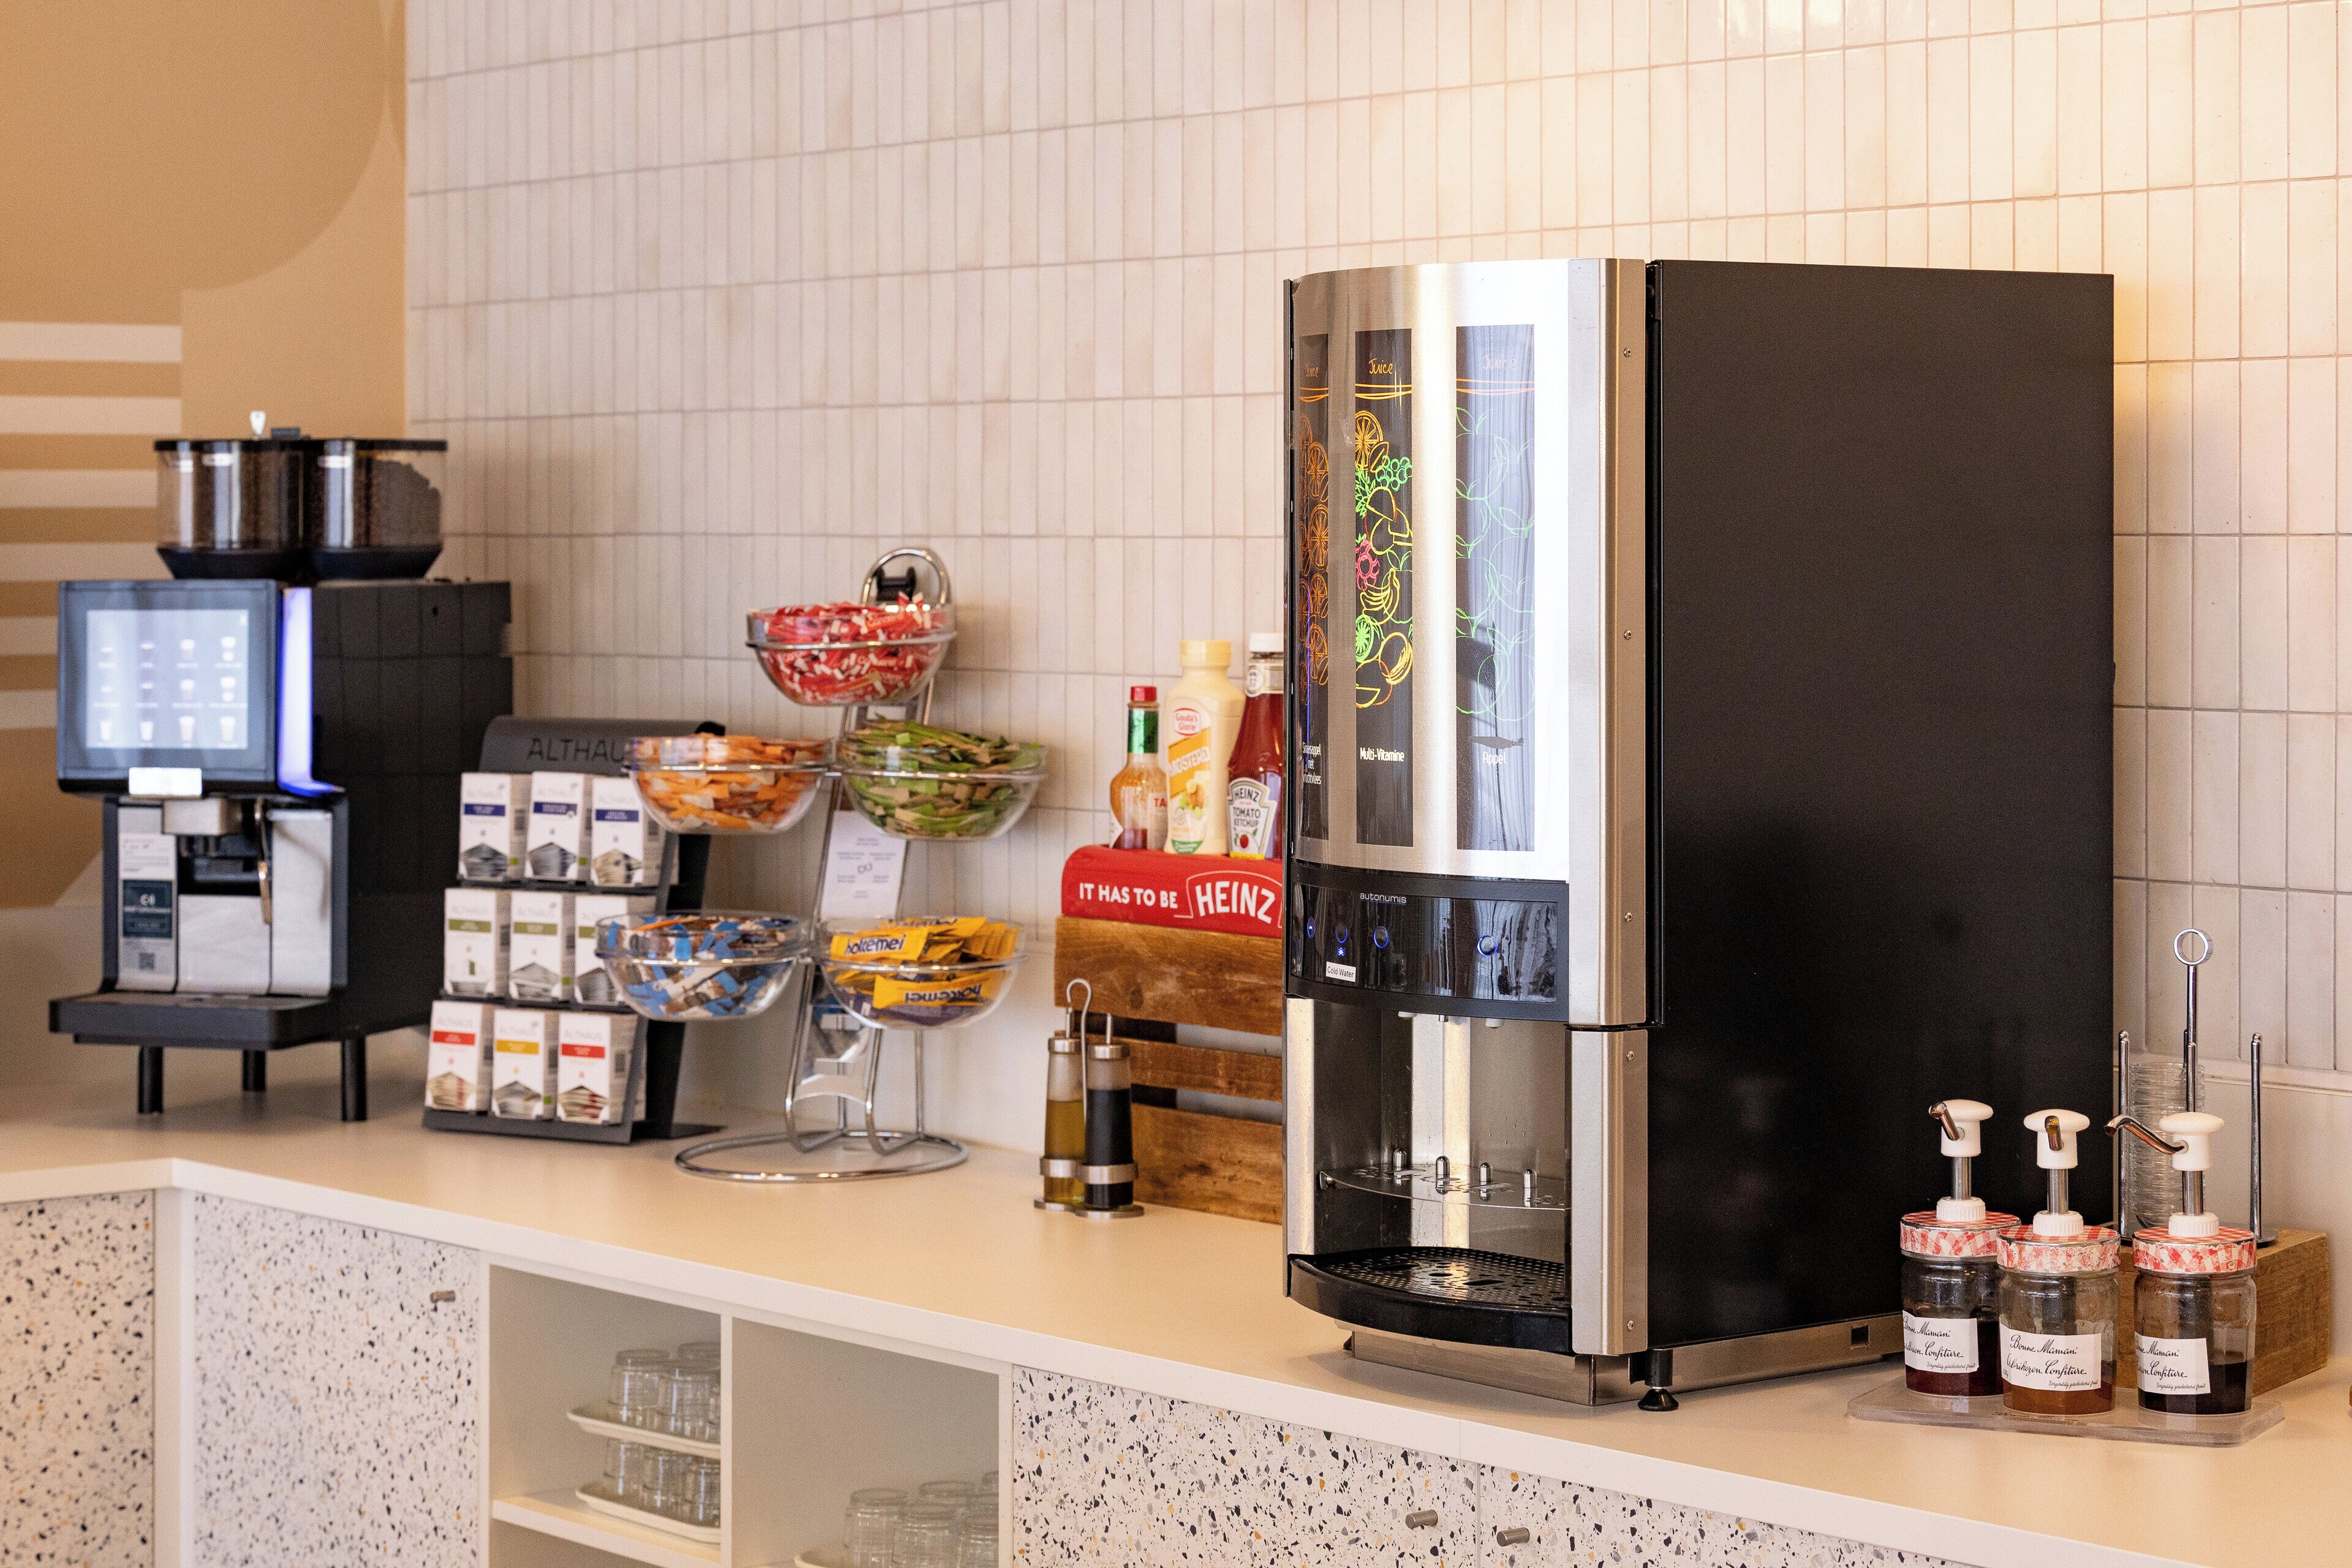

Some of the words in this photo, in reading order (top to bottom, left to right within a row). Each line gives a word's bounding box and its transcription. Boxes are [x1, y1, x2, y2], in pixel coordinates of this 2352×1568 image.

[1368, 357, 1393, 374] Juice
[1482, 355, 1516, 370] Juice
[527, 737, 625, 763] ALTHAU
[1360, 747, 1405, 762] Multi-Vitamine
[1482, 751, 1507, 766] Appel
[1234, 788, 1259, 802] HEINZ
[1233, 807, 1261, 818] TOMATO
[1234, 818, 1260, 827] KETCHUP
[1079, 882, 1095, 900] IT
[1098, 884, 1130, 904] HAS
[1133, 888, 1156, 907] TO
[1159, 890, 1178, 909] BE
[1195, 880, 1276, 924] HEINZ
[1360, 892, 1407, 903] autonumis
[1327, 966, 1339, 975] Cold
[1339, 968, 1354, 978] Water
[1917, 1321, 1950, 1337] Maman
[1924, 1341, 1964, 1360] Confiture
[2010, 1334, 2036, 1353] Bonne
[2037, 1339, 2077, 1355] Maman
[2146, 1341, 2179, 1357] Maman
[2007, 1353, 2043, 1376] Abrikozen
[2045, 1359, 2087, 1379] Confiture
[2150, 1360, 2188, 1381] Confiture
